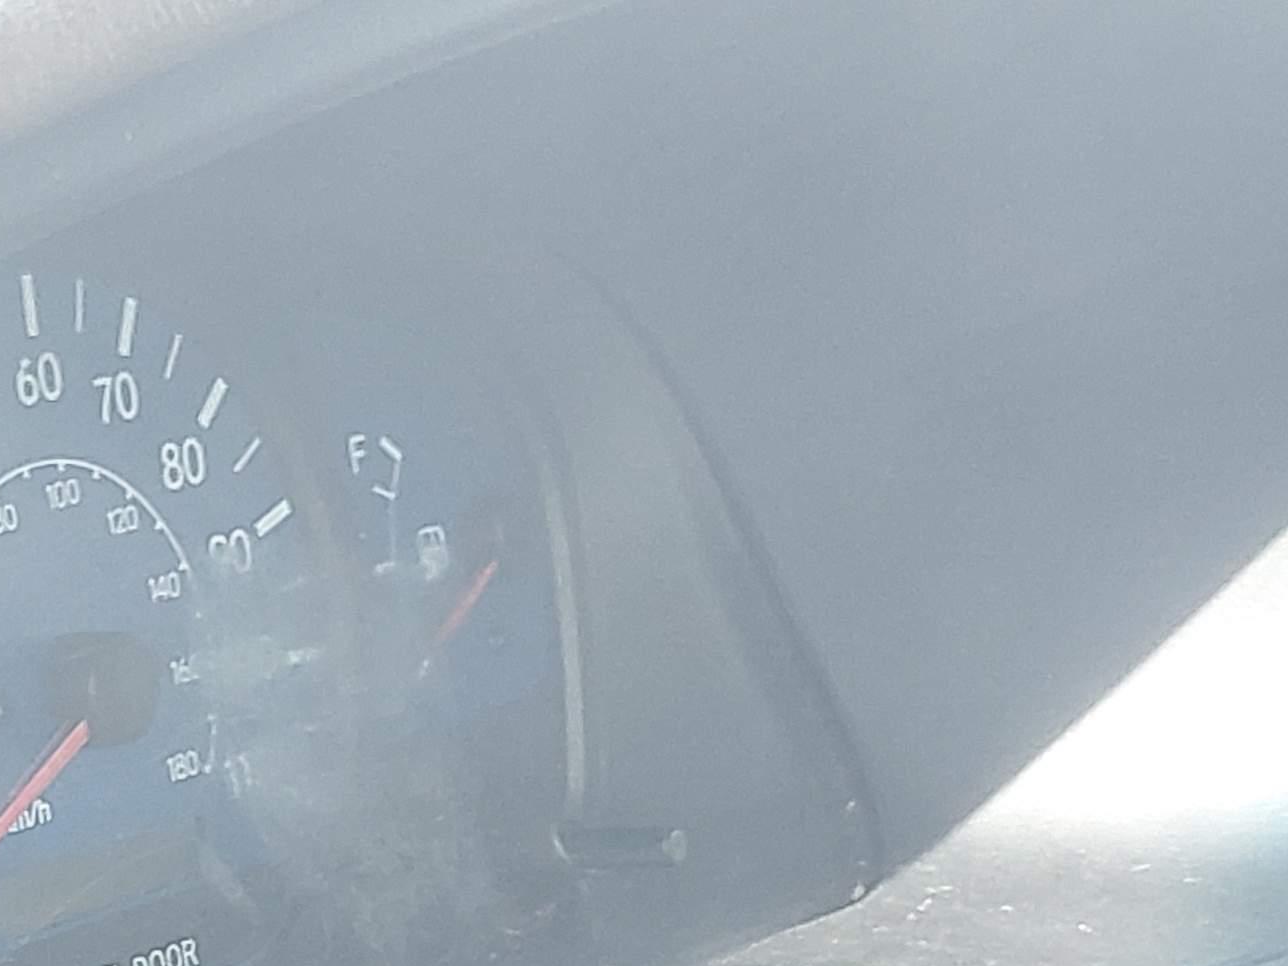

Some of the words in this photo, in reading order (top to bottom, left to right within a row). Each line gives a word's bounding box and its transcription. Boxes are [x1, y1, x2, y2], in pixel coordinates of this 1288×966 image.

[16, 352, 63, 406] 60
[92, 371, 139, 424] 70
[161, 437, 206, 491] 80
[348, 433, 366, 475] F
[45, 479, 81, 509] 100
[107, 505, 139, 535] 120
[148, 571, 181, 603] 140
[166, 750, 200, 783] 180
